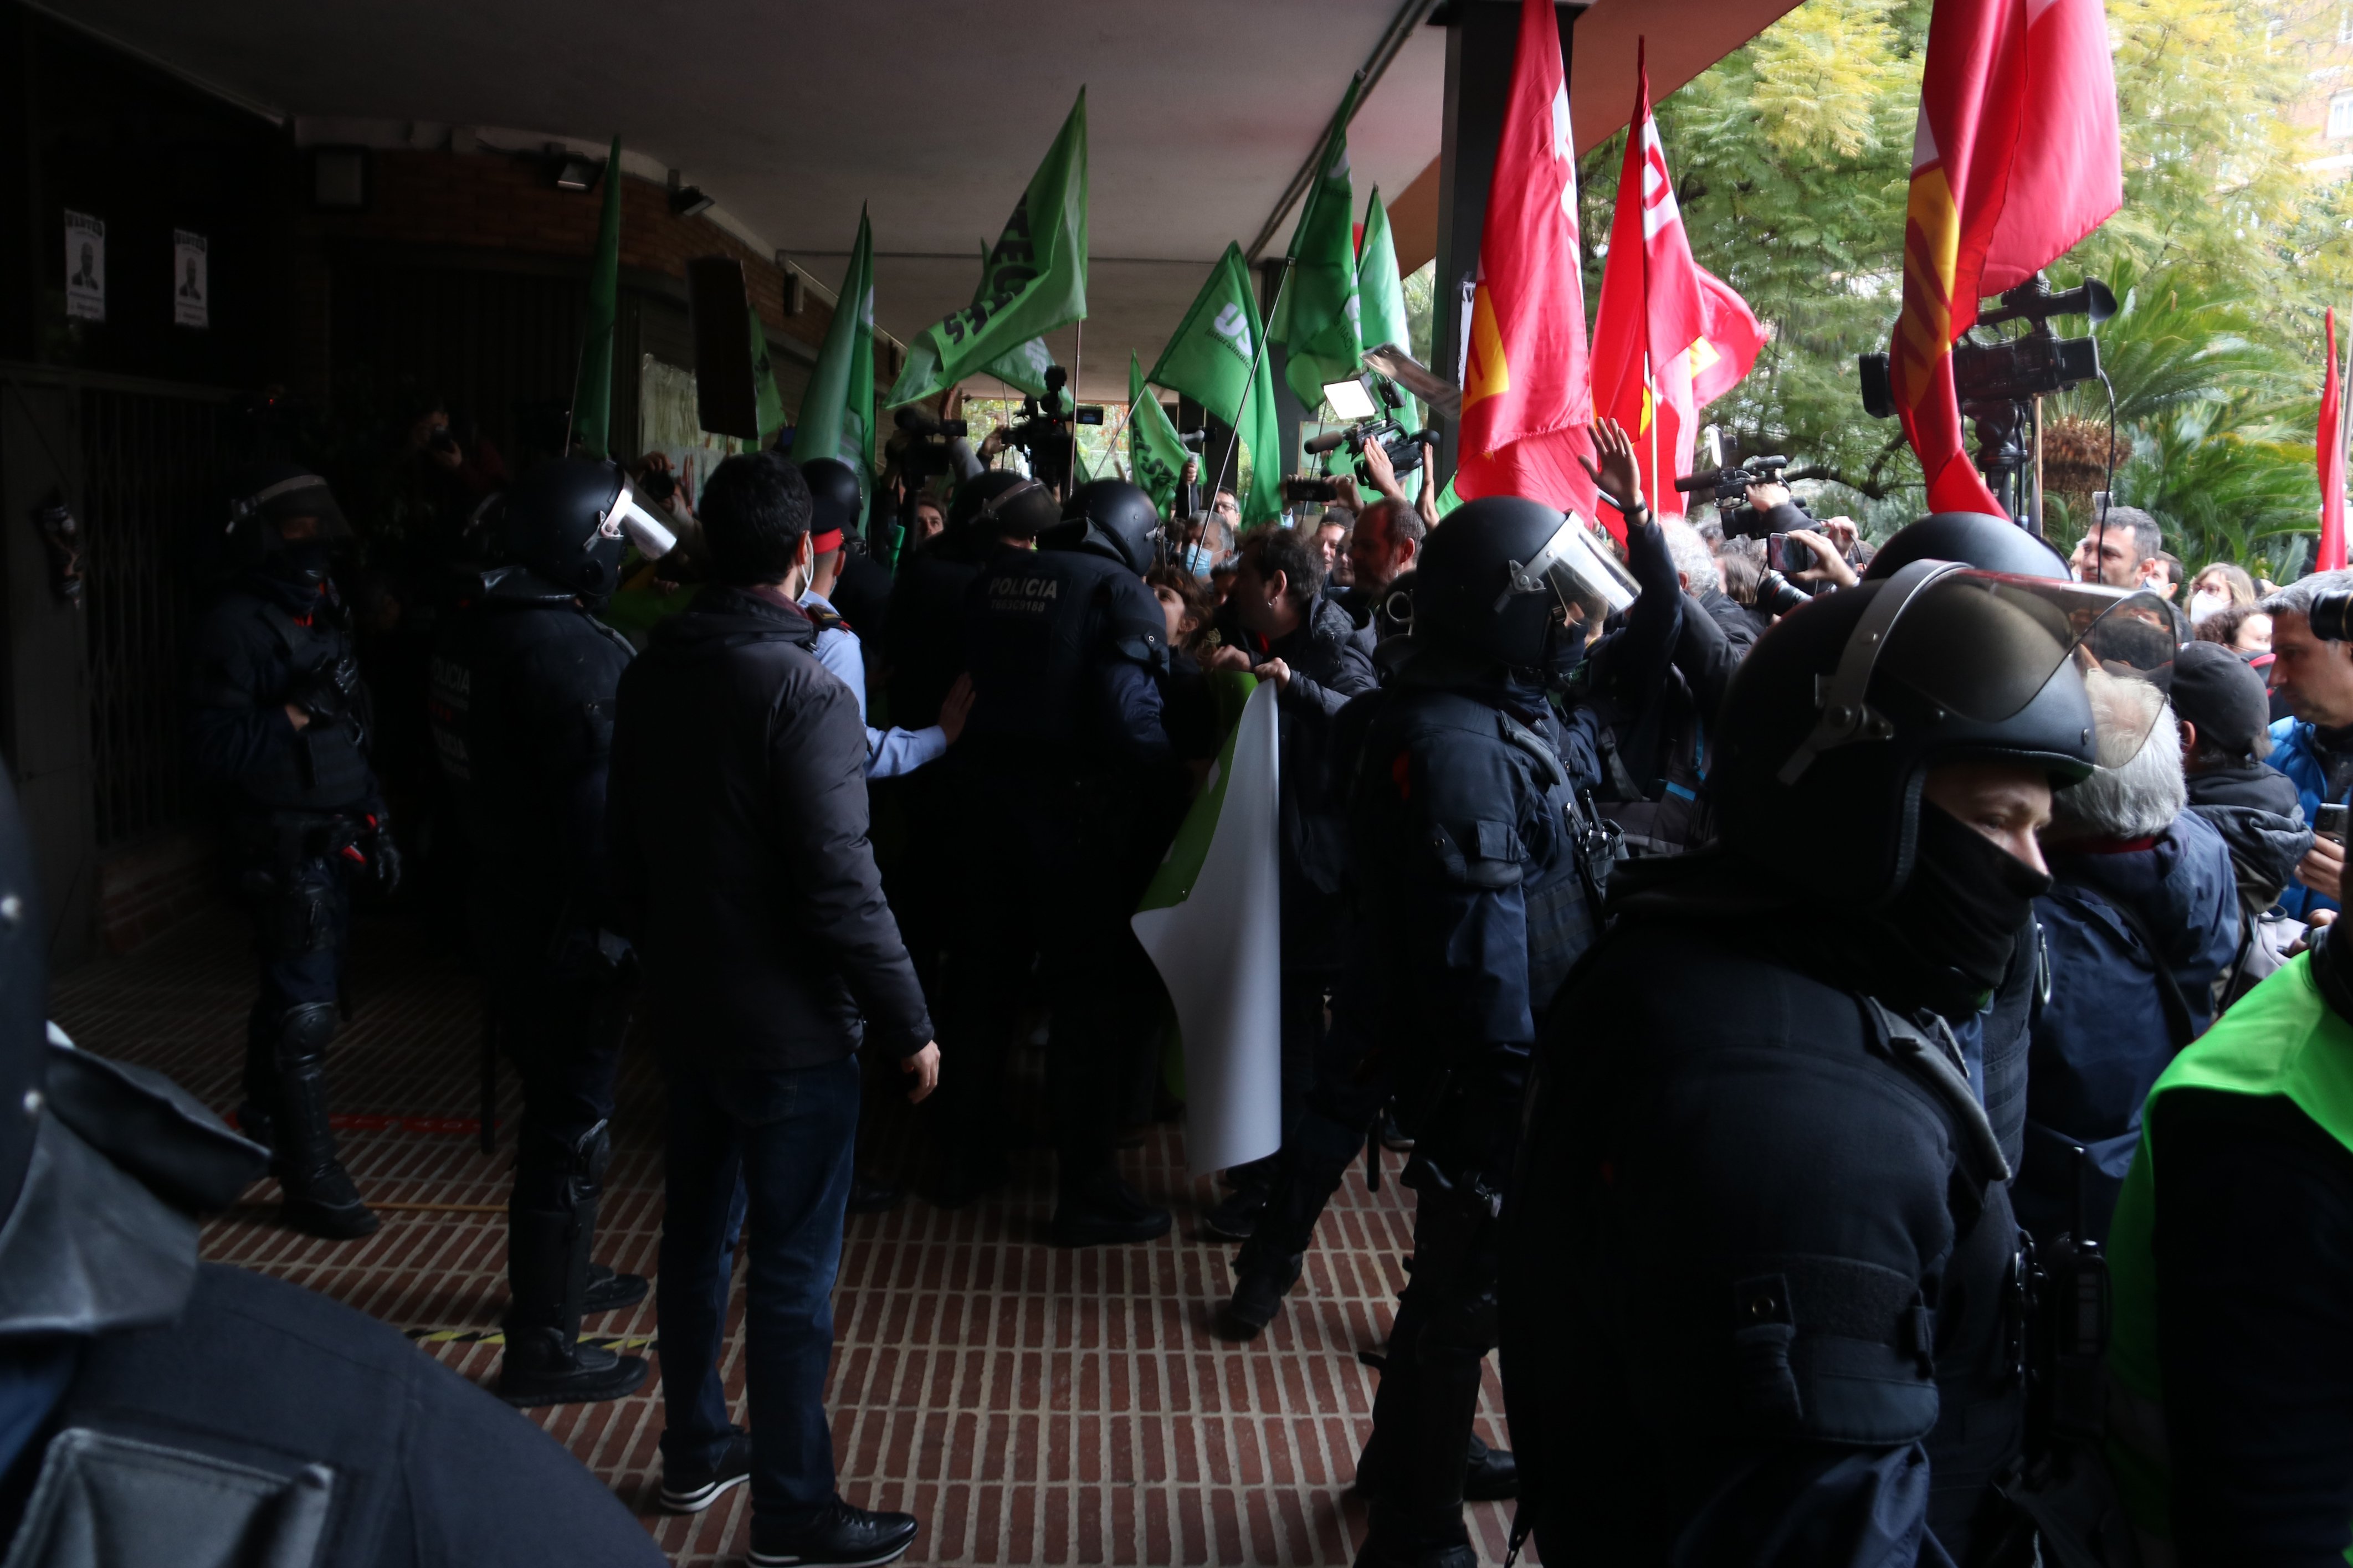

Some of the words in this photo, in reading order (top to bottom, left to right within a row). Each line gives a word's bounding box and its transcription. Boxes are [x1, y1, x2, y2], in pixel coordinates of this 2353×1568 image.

[65, 213, 102, 237] WANTED
[173, 232, 205, 253] WANTED
[988, 577, 1058, 599] POLICIA
